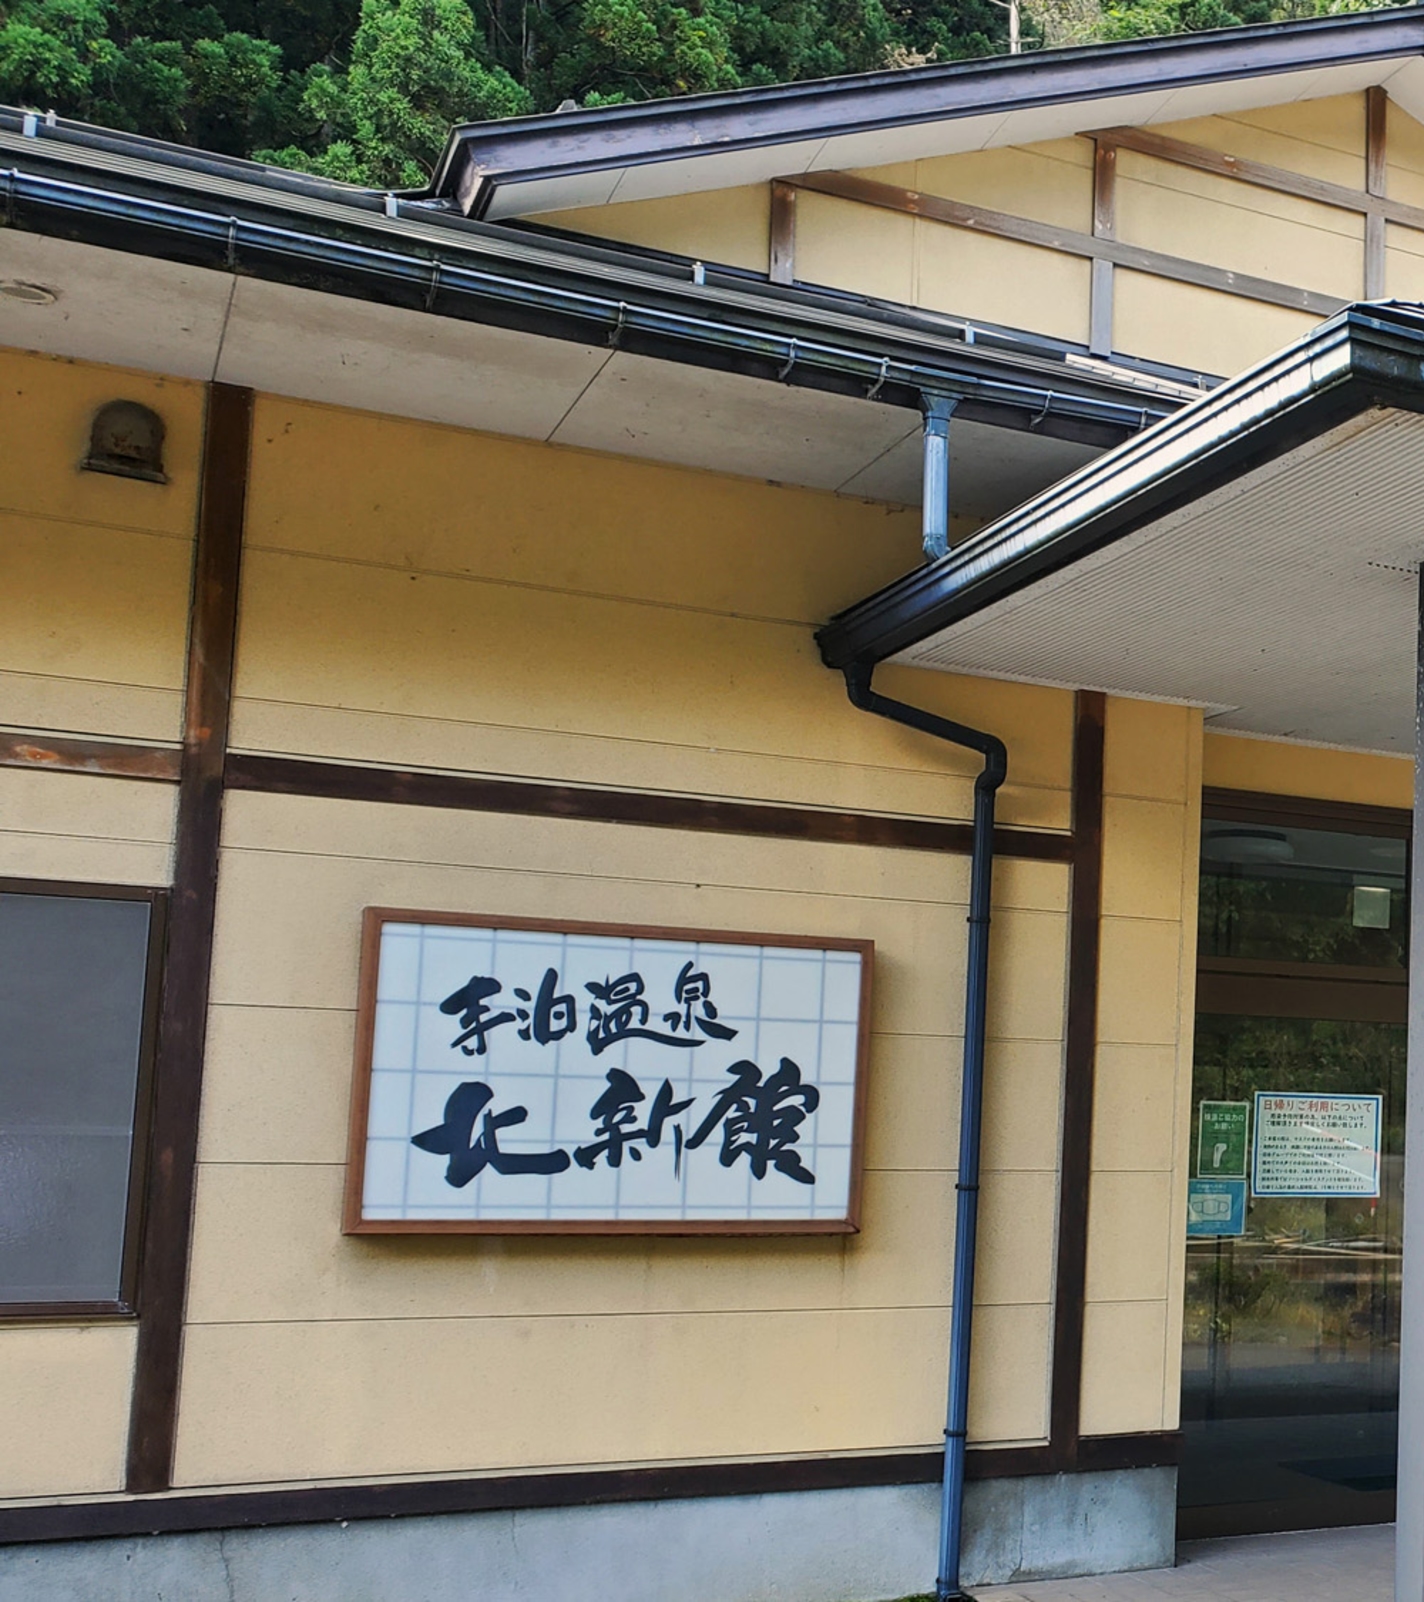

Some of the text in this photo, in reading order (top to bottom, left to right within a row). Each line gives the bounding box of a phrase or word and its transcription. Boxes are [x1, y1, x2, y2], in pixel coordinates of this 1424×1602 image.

[411, 1057, 820, 1188] 北新館
[1263, 1099, 1373, 1113] 日帰りご利用について
